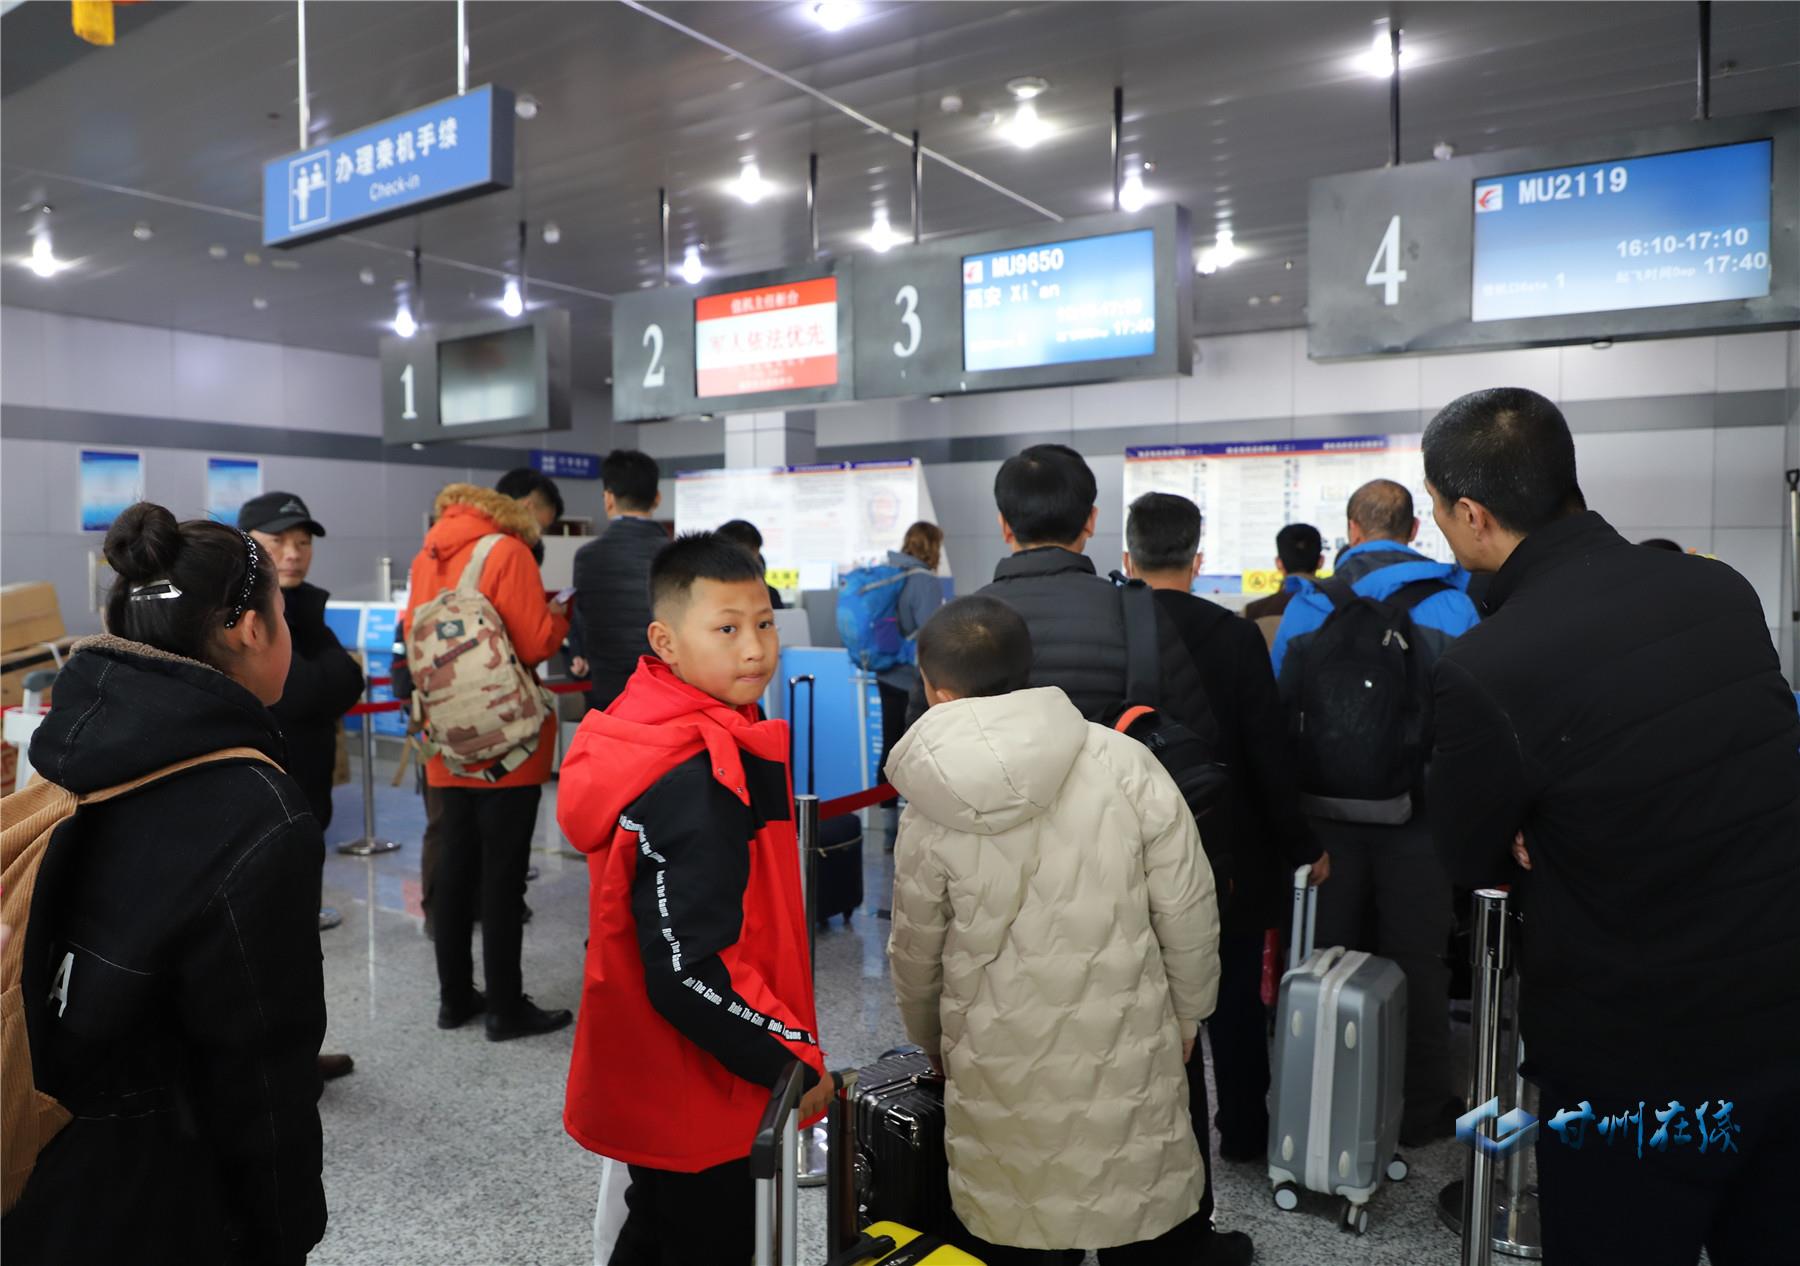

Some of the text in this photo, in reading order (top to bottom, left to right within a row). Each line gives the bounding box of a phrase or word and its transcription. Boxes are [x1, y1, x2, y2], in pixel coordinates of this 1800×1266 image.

[335, 116, 459, 184] 办理乘机手续
[369, 173, 421, 201] Check-in
[1518, 166, 1628, 206] MU2119
[1365, 215, 1407, 305] 4
[1616, 227, 1749, 258] 16:10-17:10
[991, 248, 1064, 278] MU9650
[1703, 251, 1768, 275] 17:40
[893, 285, 922, 358] 3
[642, 323, 665, 389] 2
[399, 363, 418, 420] 1
[691, 979, 707, 995] The
[703, 987, 723, 1006] Game
